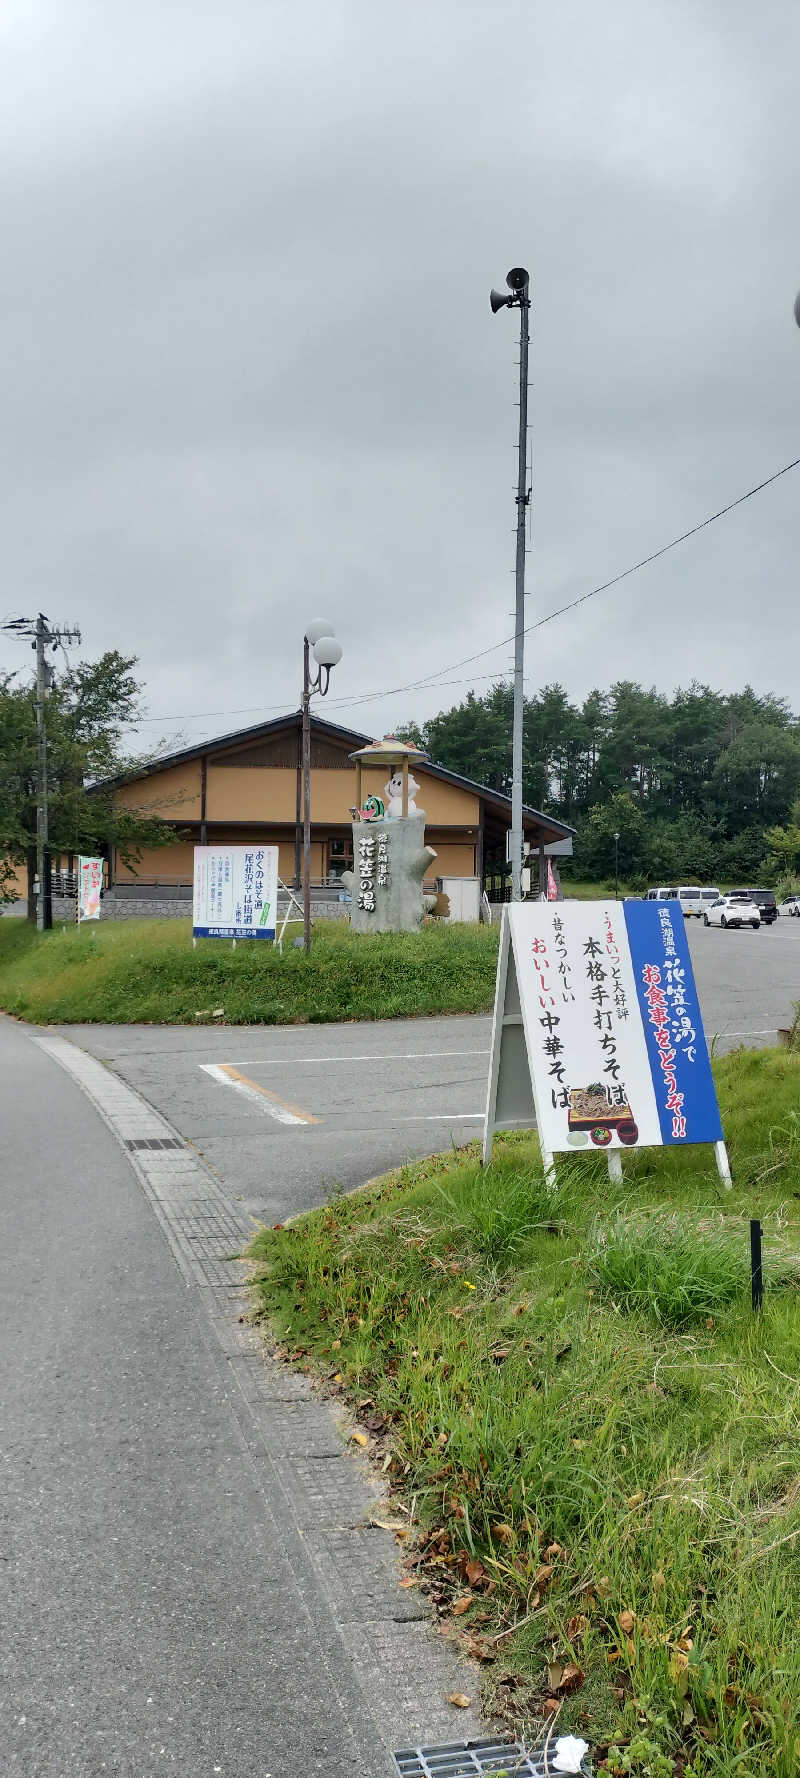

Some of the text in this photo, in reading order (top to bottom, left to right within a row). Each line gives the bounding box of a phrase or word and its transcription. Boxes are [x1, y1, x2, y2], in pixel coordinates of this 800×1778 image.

[243, 853, 254, 924] 尾花沢そば街道
[357, 837, 376, 912] 花笠の湯
[377, 833, 389, 886] 徳良湖温泉
[531, 937, 573, 1110] おいしい中華そば
[583, 937, 629, 1107] 本格手打ちそば
